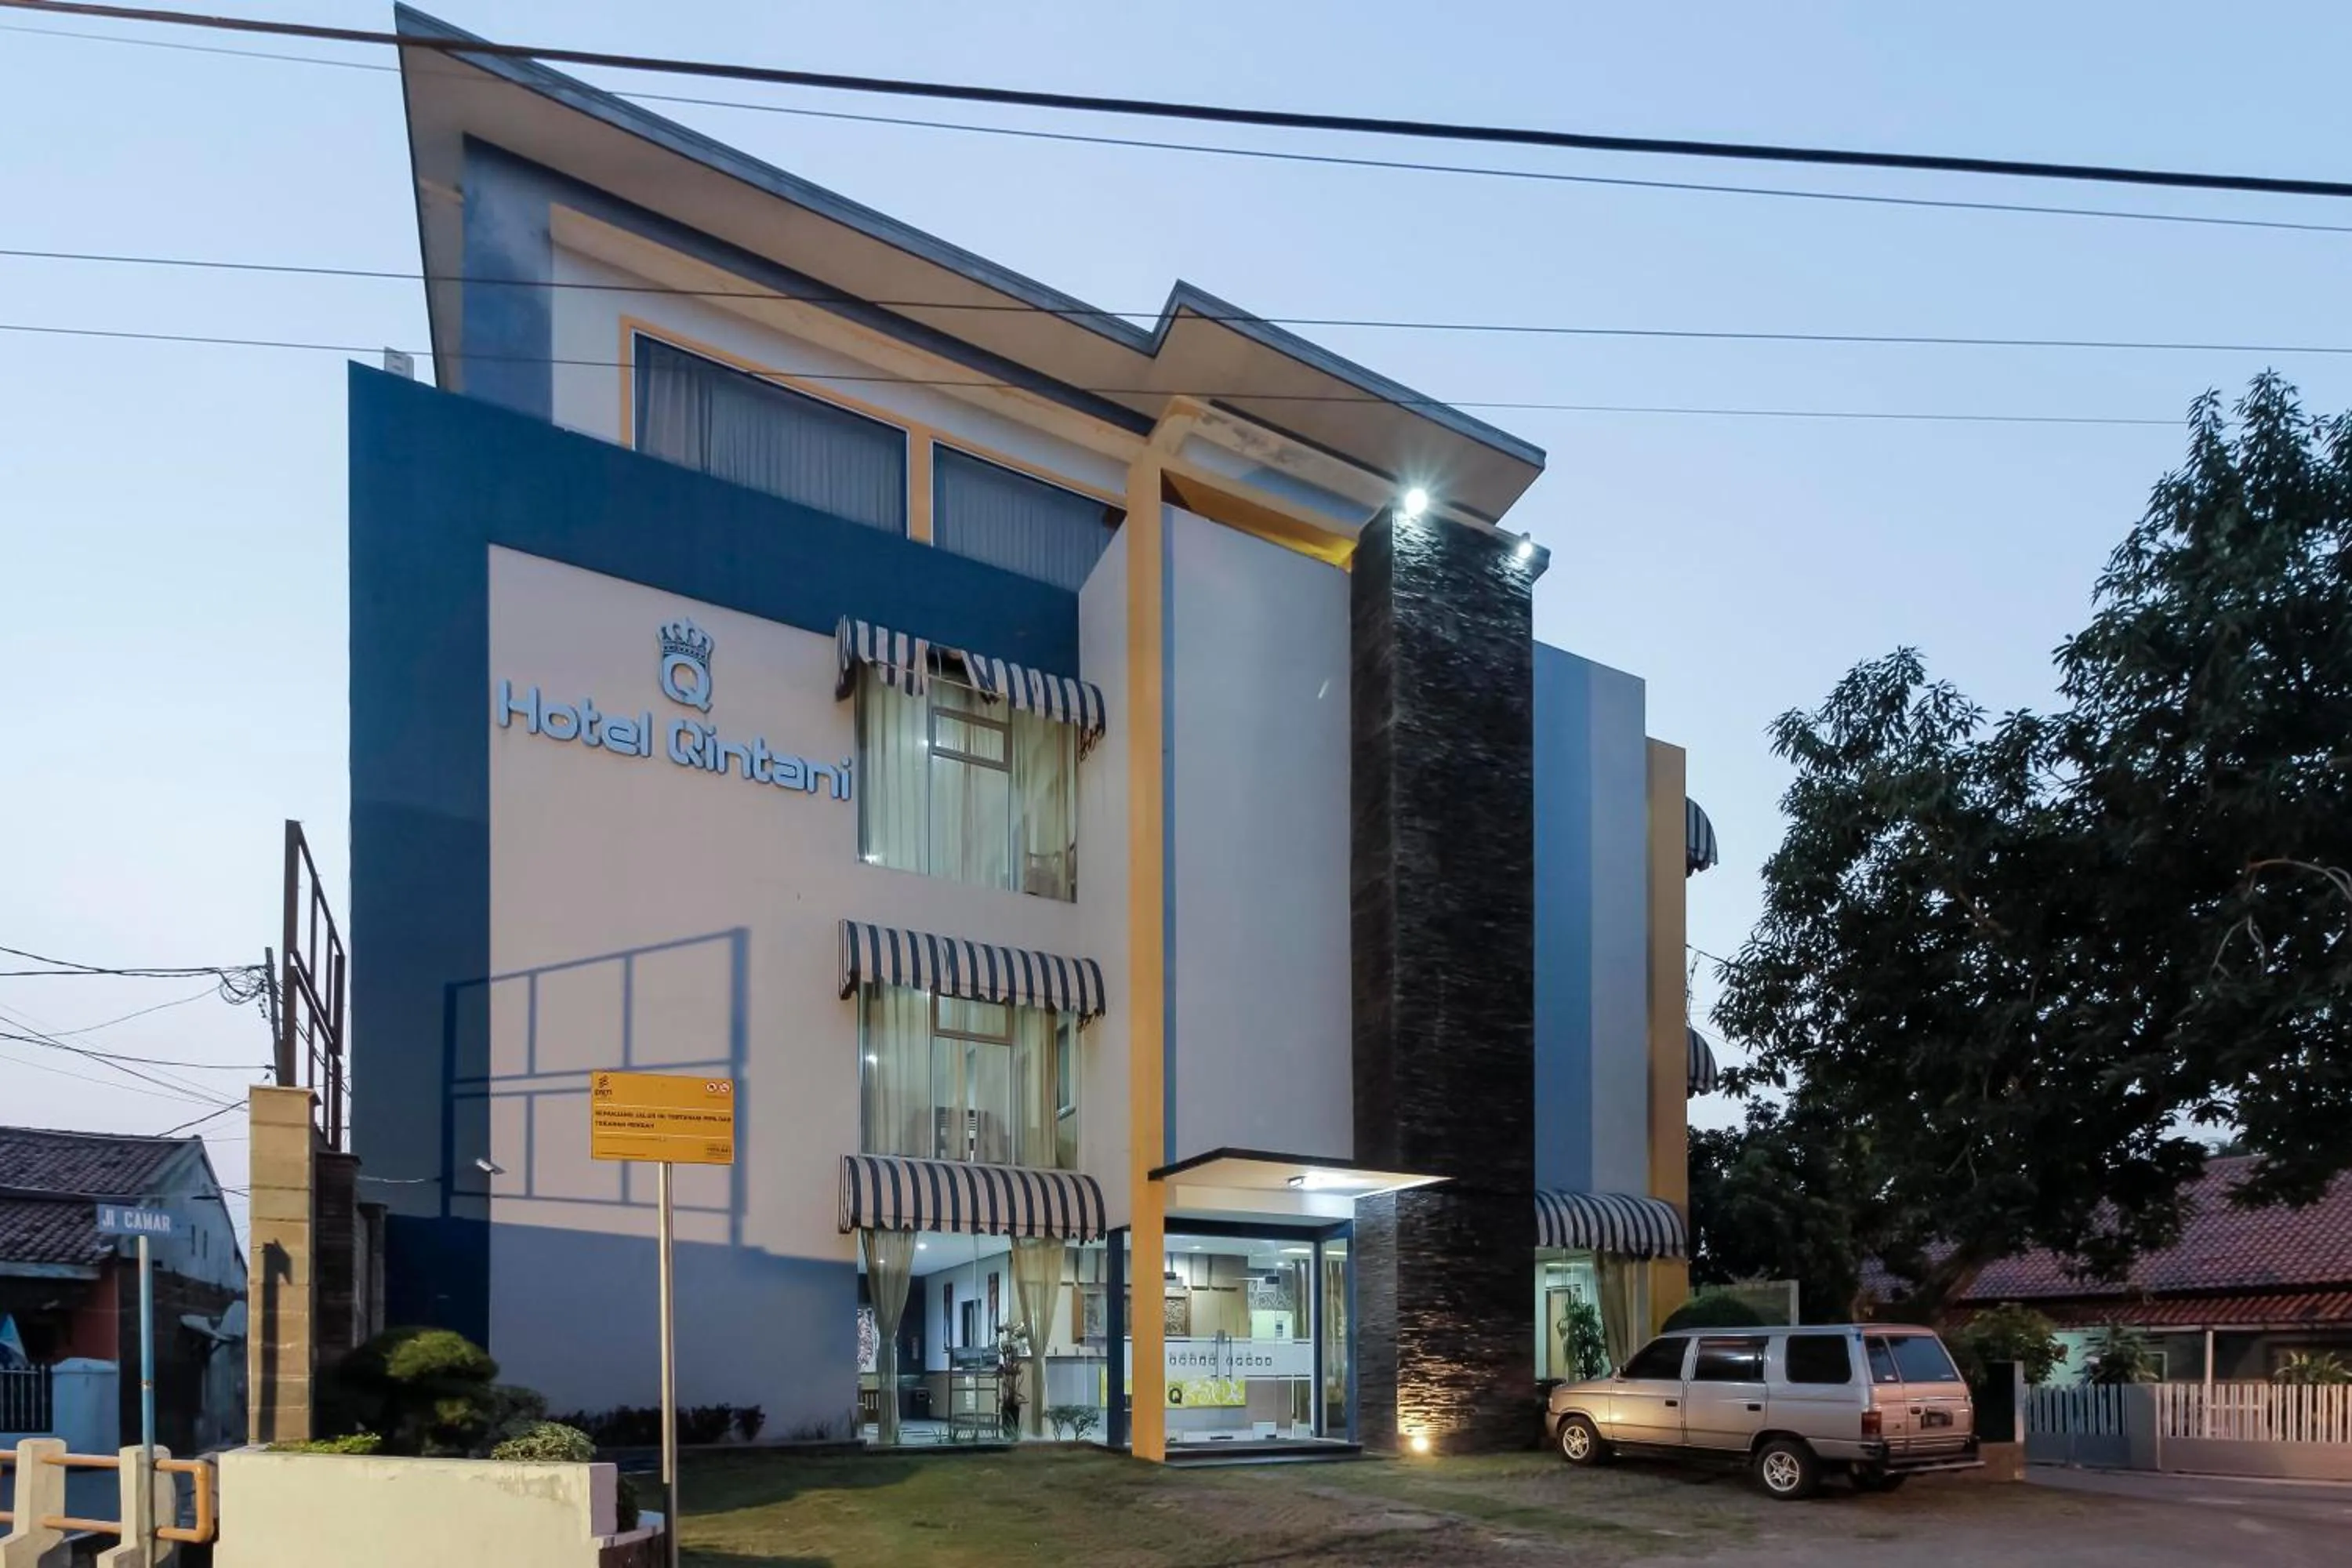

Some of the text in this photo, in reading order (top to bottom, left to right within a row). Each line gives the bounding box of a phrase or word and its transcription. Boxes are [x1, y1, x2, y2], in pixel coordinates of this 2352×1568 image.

[659, 652, 713, 713] Q
[496, 678, 853, 801] Hotel Qintani
[124, 1210, 171, 1233] CAMAR
[1168, 1387, 1183, 1405] Q
